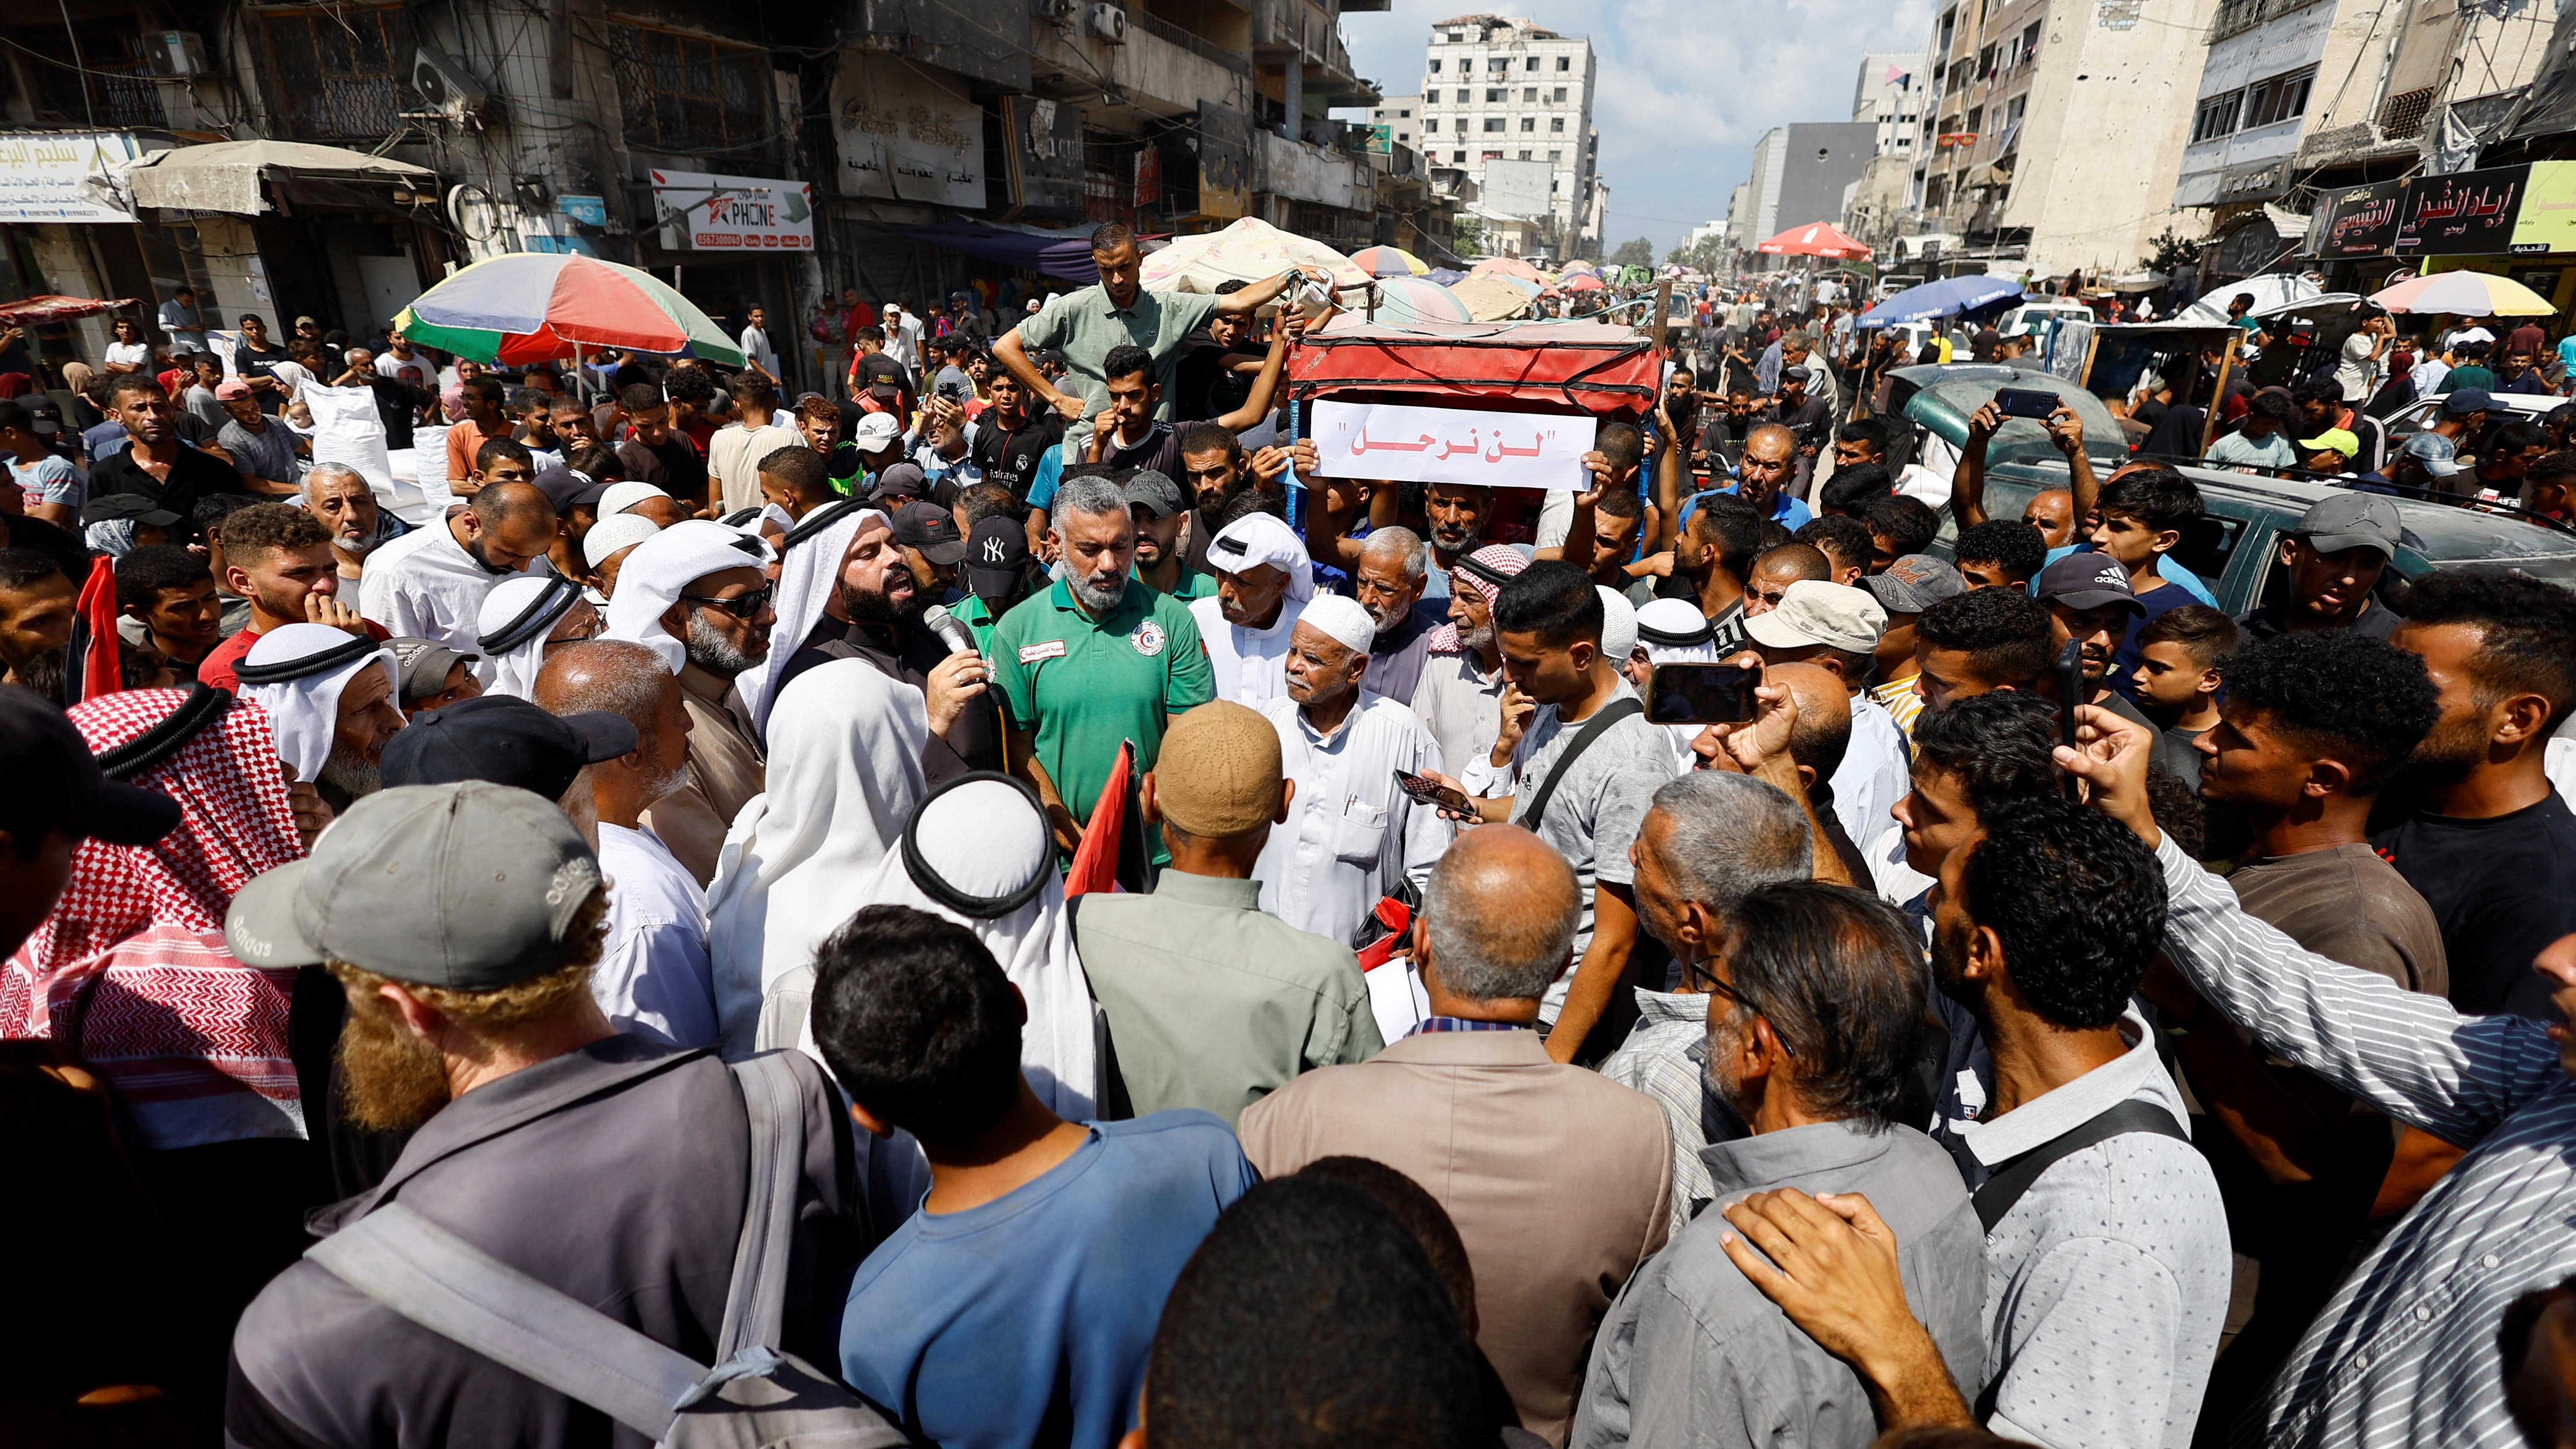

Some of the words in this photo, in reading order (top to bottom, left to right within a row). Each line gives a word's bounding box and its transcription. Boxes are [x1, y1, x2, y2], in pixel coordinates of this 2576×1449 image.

[34, 138, 79, 169] سليم
[2413, 179, 2471, 229] الشوا
[2467, 182, 2514, 228] إياد
[1913, 308, 1943, 321] Bavaria
[2095, 576, 2129, 589] adidas
[404, 644, 428, 666] adidas
[233, 915, 272, 957] adidas
